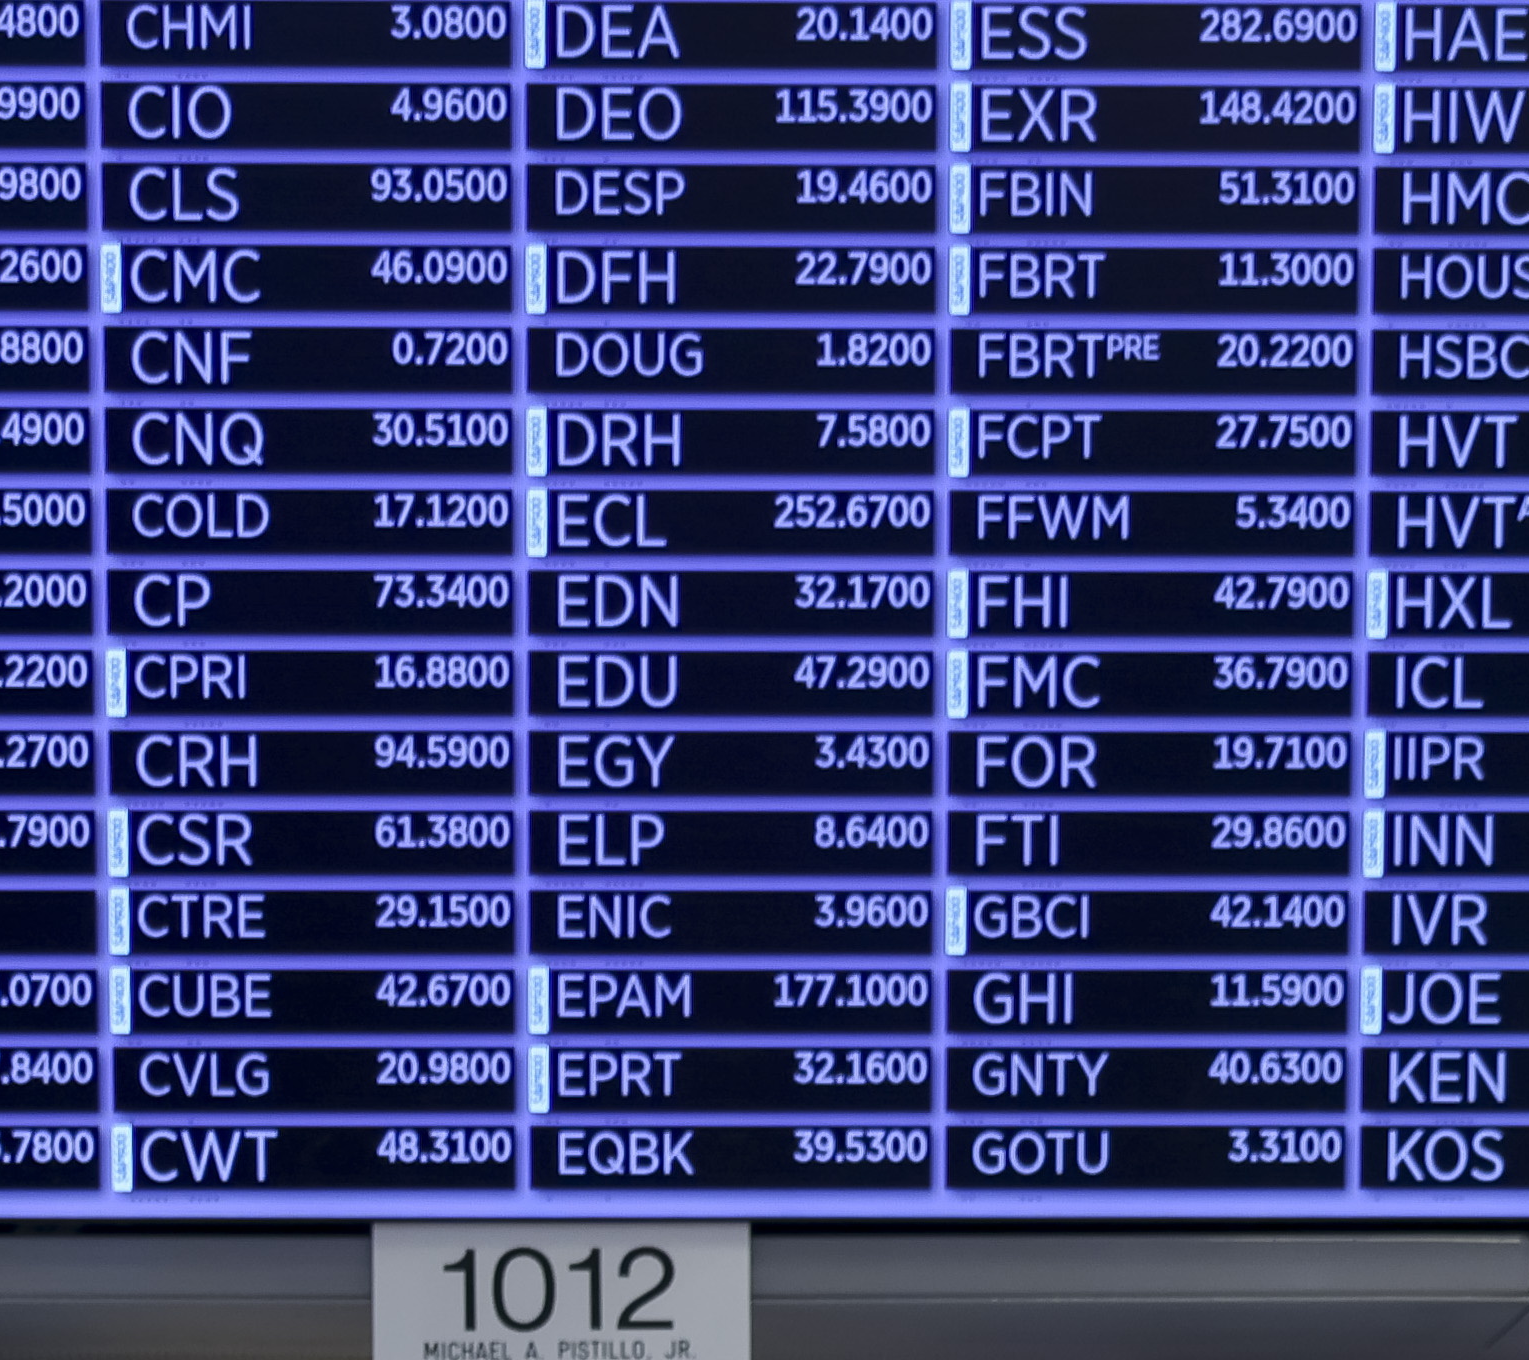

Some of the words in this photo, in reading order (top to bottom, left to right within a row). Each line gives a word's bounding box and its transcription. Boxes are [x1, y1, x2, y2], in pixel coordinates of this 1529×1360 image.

[1404, 6, 1529, 62] HAE
[555, 85, 684, 141] DEO
[775, 87, 934, 124] 115.3900
[979, 87, 1098, 143] EXR
[1199, 88, 1358, 125] 148.4200
[128, 165, 240, 222] CLS
[369, 166, 509, 203] 93.0500
[978, 250, 1108, 299] FBRT
[1217, 250, 1356, 287] 11.3000
[130, 328, 253, 385] CNF
[391, 329, 510, 366] 0.7200
[555, 329, 705, 378] DOUG
[816, 330, 933, 367] 1.8200
[1398, 412, 1520, 469] HVT
[556, 492, 668, 548] ECL
[773, 492, 932, 529] 252.6700
[977, 492, 1131, 540] FFWM
[1235, 493, 1352, 530] 5.3400
[133, 571, 212, 628] CP
[373, 572, 511, 609] 73.3400
[976, 653, 1101, 709] FMC
[1212, 653, 1350, 690] 36.7900
[1395, 654, 1485, 710] ICL
[135, 732, 258, 788] CRH
[373, 732, 511, 769] 94.5900
[557, 733, 676, 788] EGY
[814, 733, 931, 769] 3.4300
[1392, 813, 1495, 867] INN
[556, 892, 672, 939] ENIC
[814, 892, 930, 929] 3.9600
[973, 892, 1090, 939] GBCI
[1209, 893, 1347, 929] 42.1400
[137, 972, 273, 1019] CUBE
[375, 971, 513, 1008] 42.6700
[972, 1050, 1110, 1097] GNTY
[1207, 1049, 1344, 1085] 40.6300
[1388, 1049, 1508, 1104] KEN
[139, 1128, 279, 1183] CWT
[376, 1128, 513, 1164] 48.3100
[557, 1129, 695, 1176] EQBK
[793, 1128, 929, 1164] 39.5300
[443, 1247, 675, 1332] 1012
[423, 1341, 512, 1360] MICHAEL
